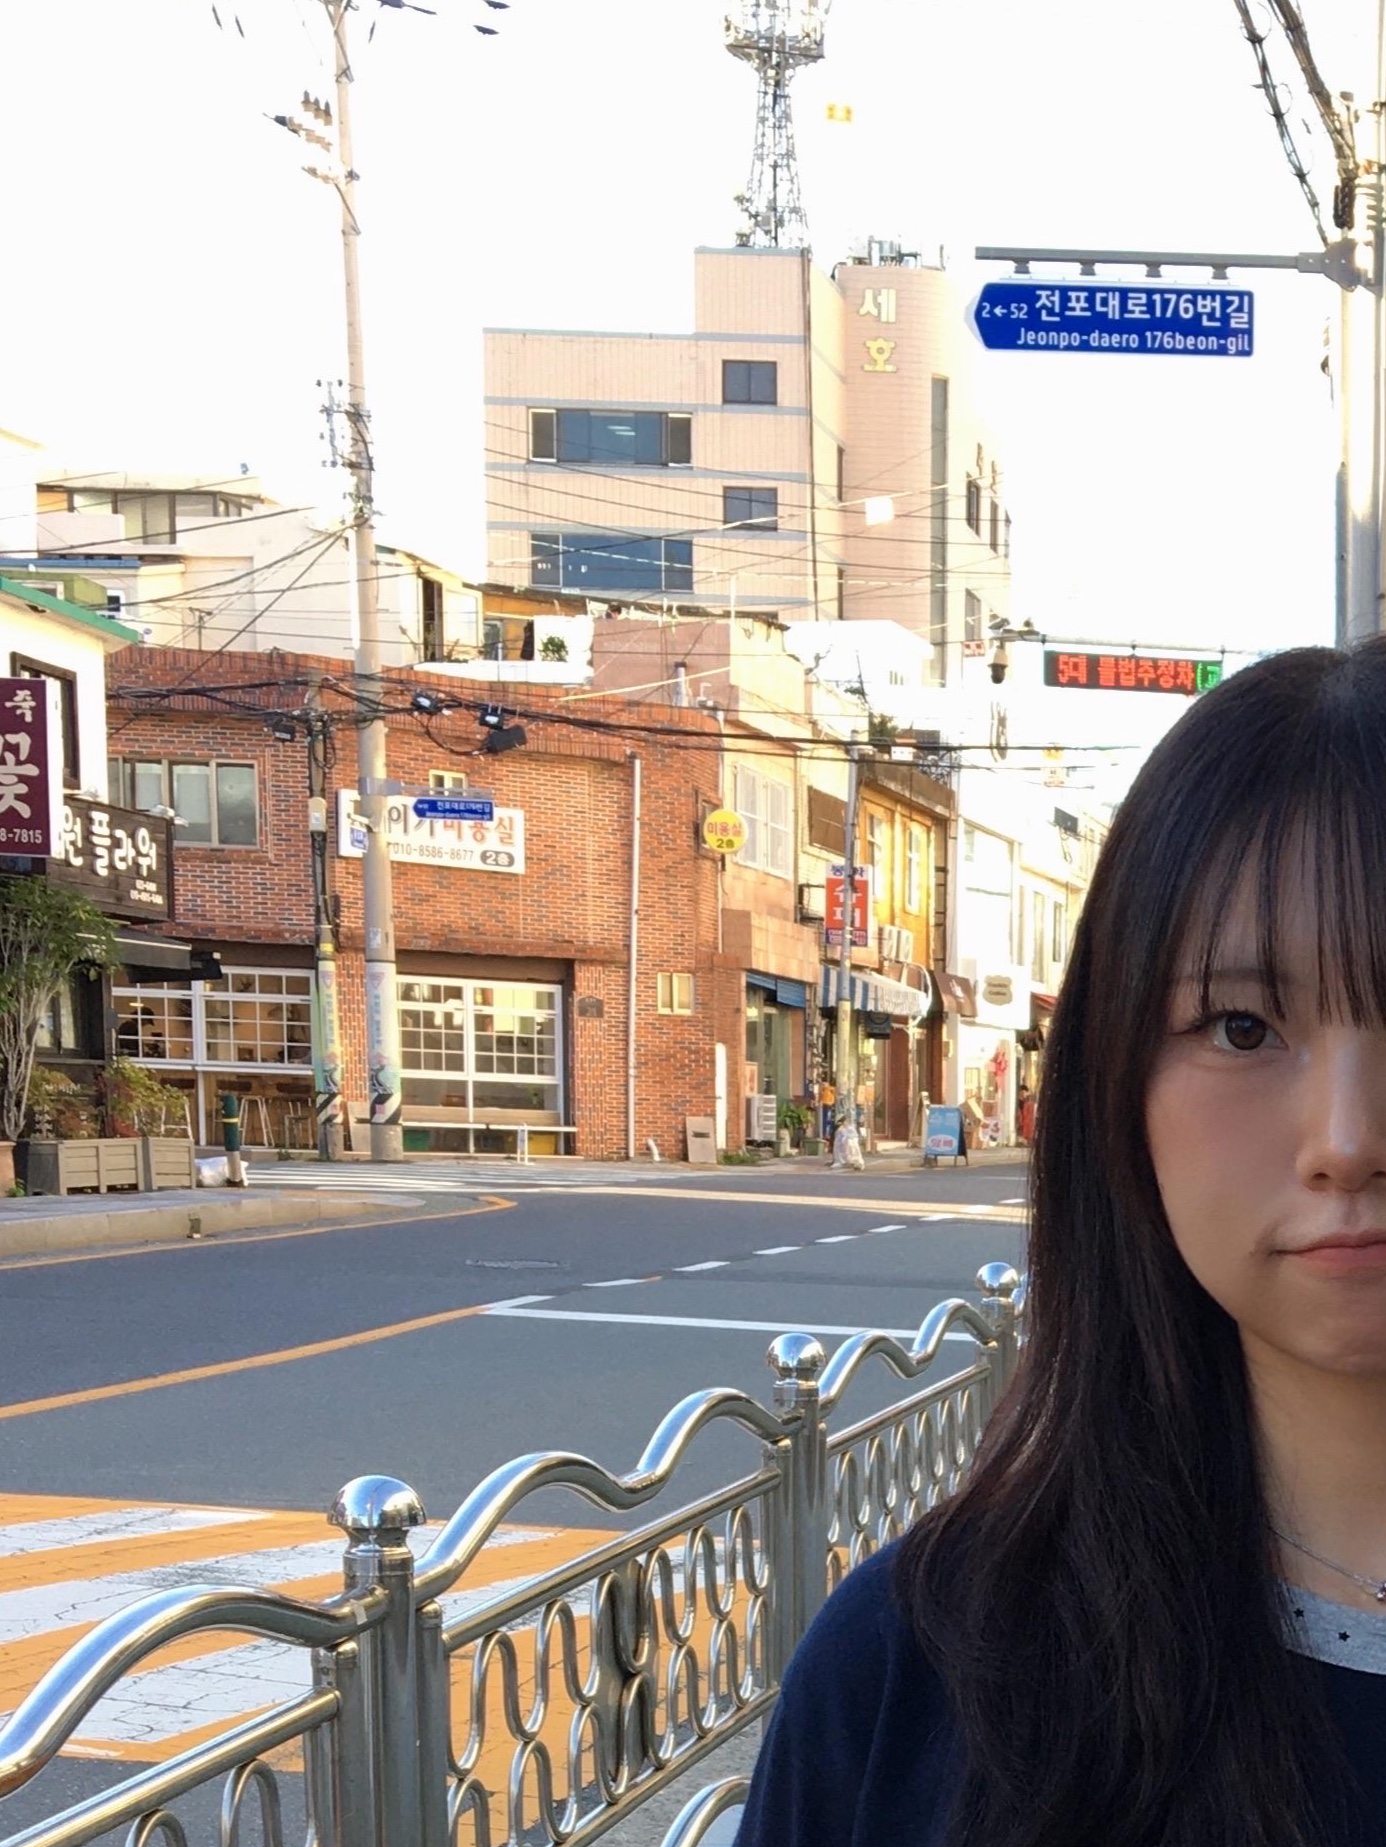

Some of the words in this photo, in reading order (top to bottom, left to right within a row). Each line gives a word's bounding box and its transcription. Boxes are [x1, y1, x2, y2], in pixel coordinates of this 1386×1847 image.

[981, 302, 991, 318] 2
[1010, 303, 1028, 319] 52
[1035, 289, 1250, 329] 전포대로176번길
[858, 287, 898, 373] 세호
[1017, 327, 1139, 349] Jeonpo-daero
[1145, 331, 1250, 354] 176beon-gil
[1097, 656, 1194, 690] 불법주정차
[88, 810, 157, 877] 플라워
